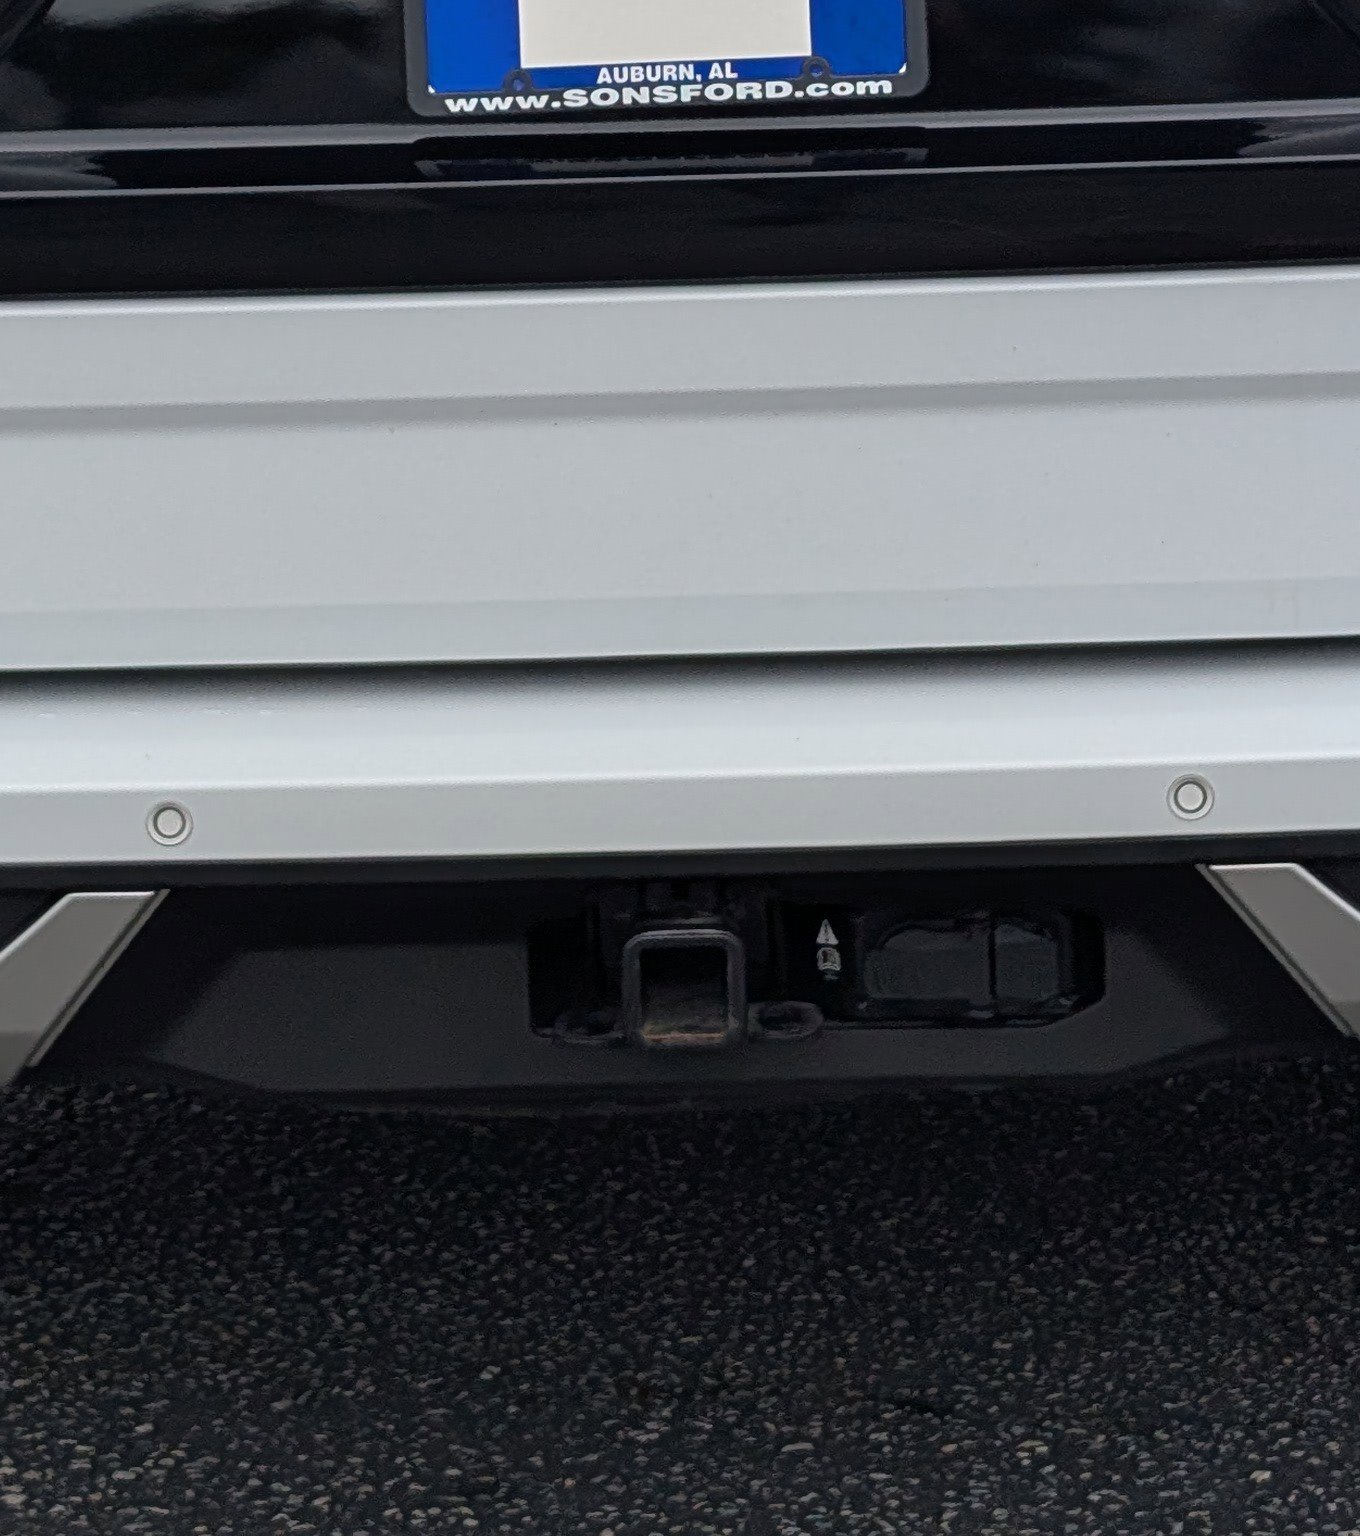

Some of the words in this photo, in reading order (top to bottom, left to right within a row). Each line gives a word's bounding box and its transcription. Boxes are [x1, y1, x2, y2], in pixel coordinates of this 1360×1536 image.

[596, 64, 702, 85] AUBURN,
[709, 62, 738, 80] AL
[445, 78, 893, 114] www.SONSFORD.com
